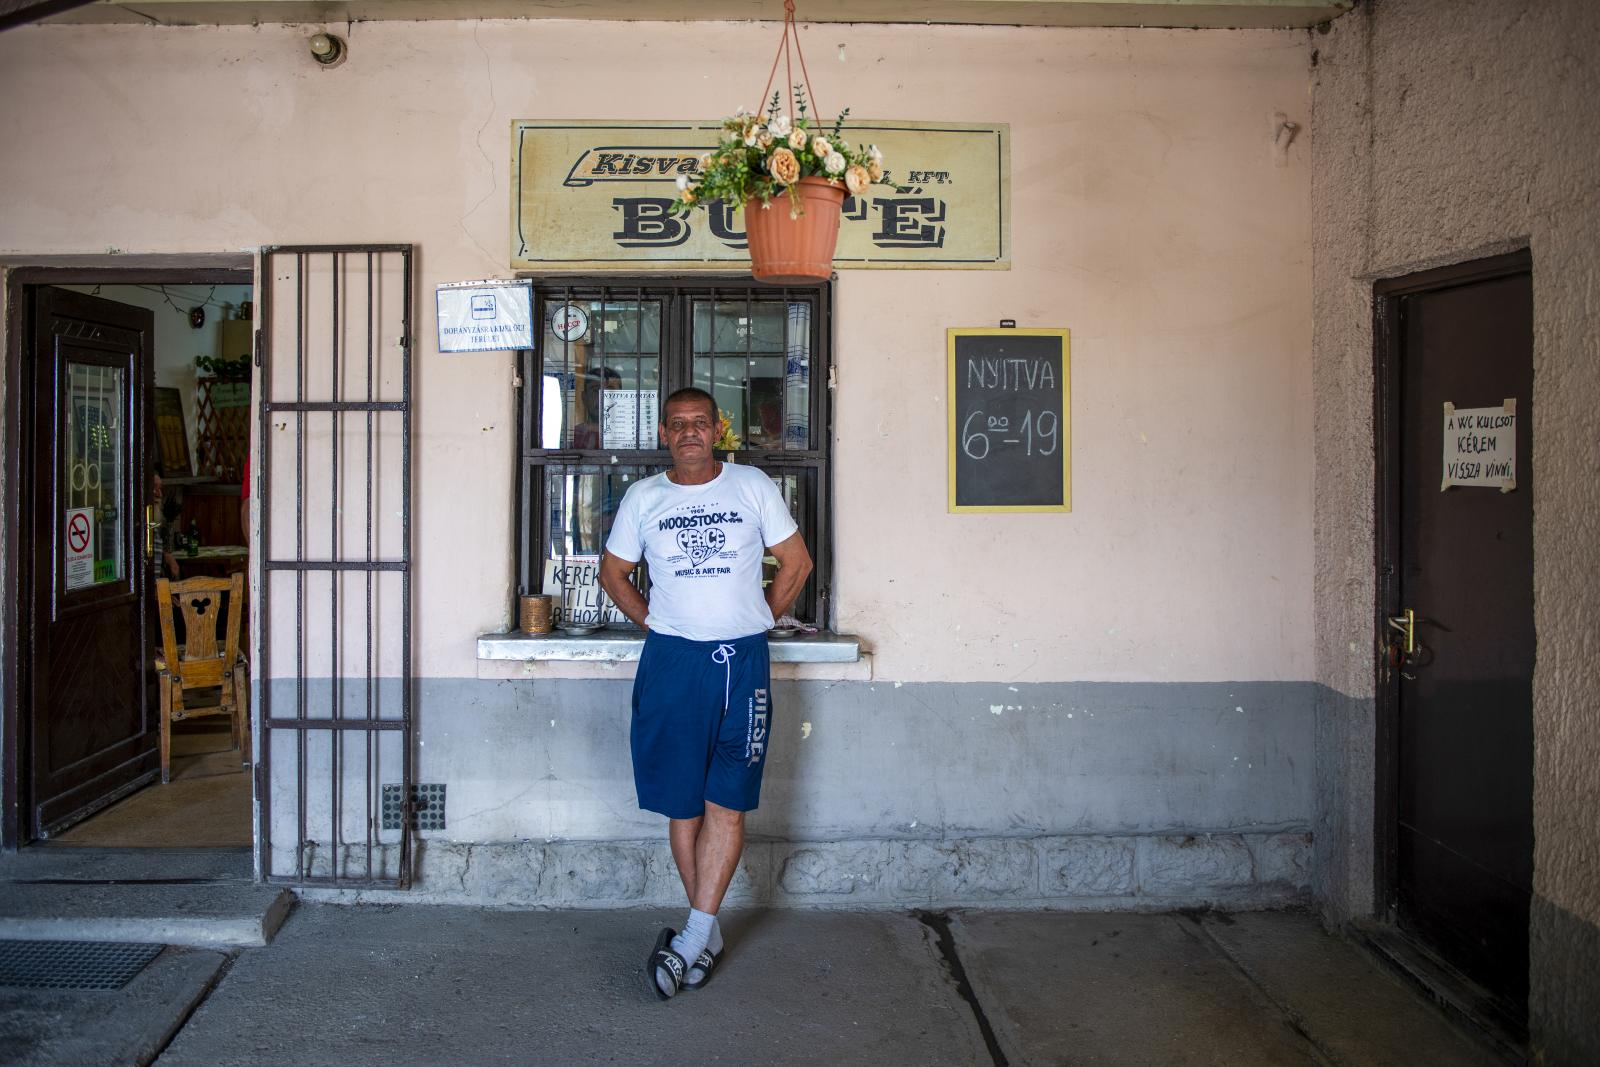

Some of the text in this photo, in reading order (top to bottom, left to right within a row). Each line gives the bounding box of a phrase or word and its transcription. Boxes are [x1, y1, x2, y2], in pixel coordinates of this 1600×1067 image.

[591, 153, 700, 175] Kisva
[907, 170, 953, 184] KFT.
[968, 348, 1055, 391] NYITVA
[1448, 414, 1516, 430] A WC KULCSOT
[1457, 432, 1497, 454] KÉREM
[1448, 458, 1480, 479] VISSZA
[659, 512, 729, 531] WOODSTOCK
[552, 564, 600, 587] KERÉK
[675, 568, 695, 577] MUSIC
[702, 567, 716, 575] ART
[716, 566, 731, 574] FAIR
